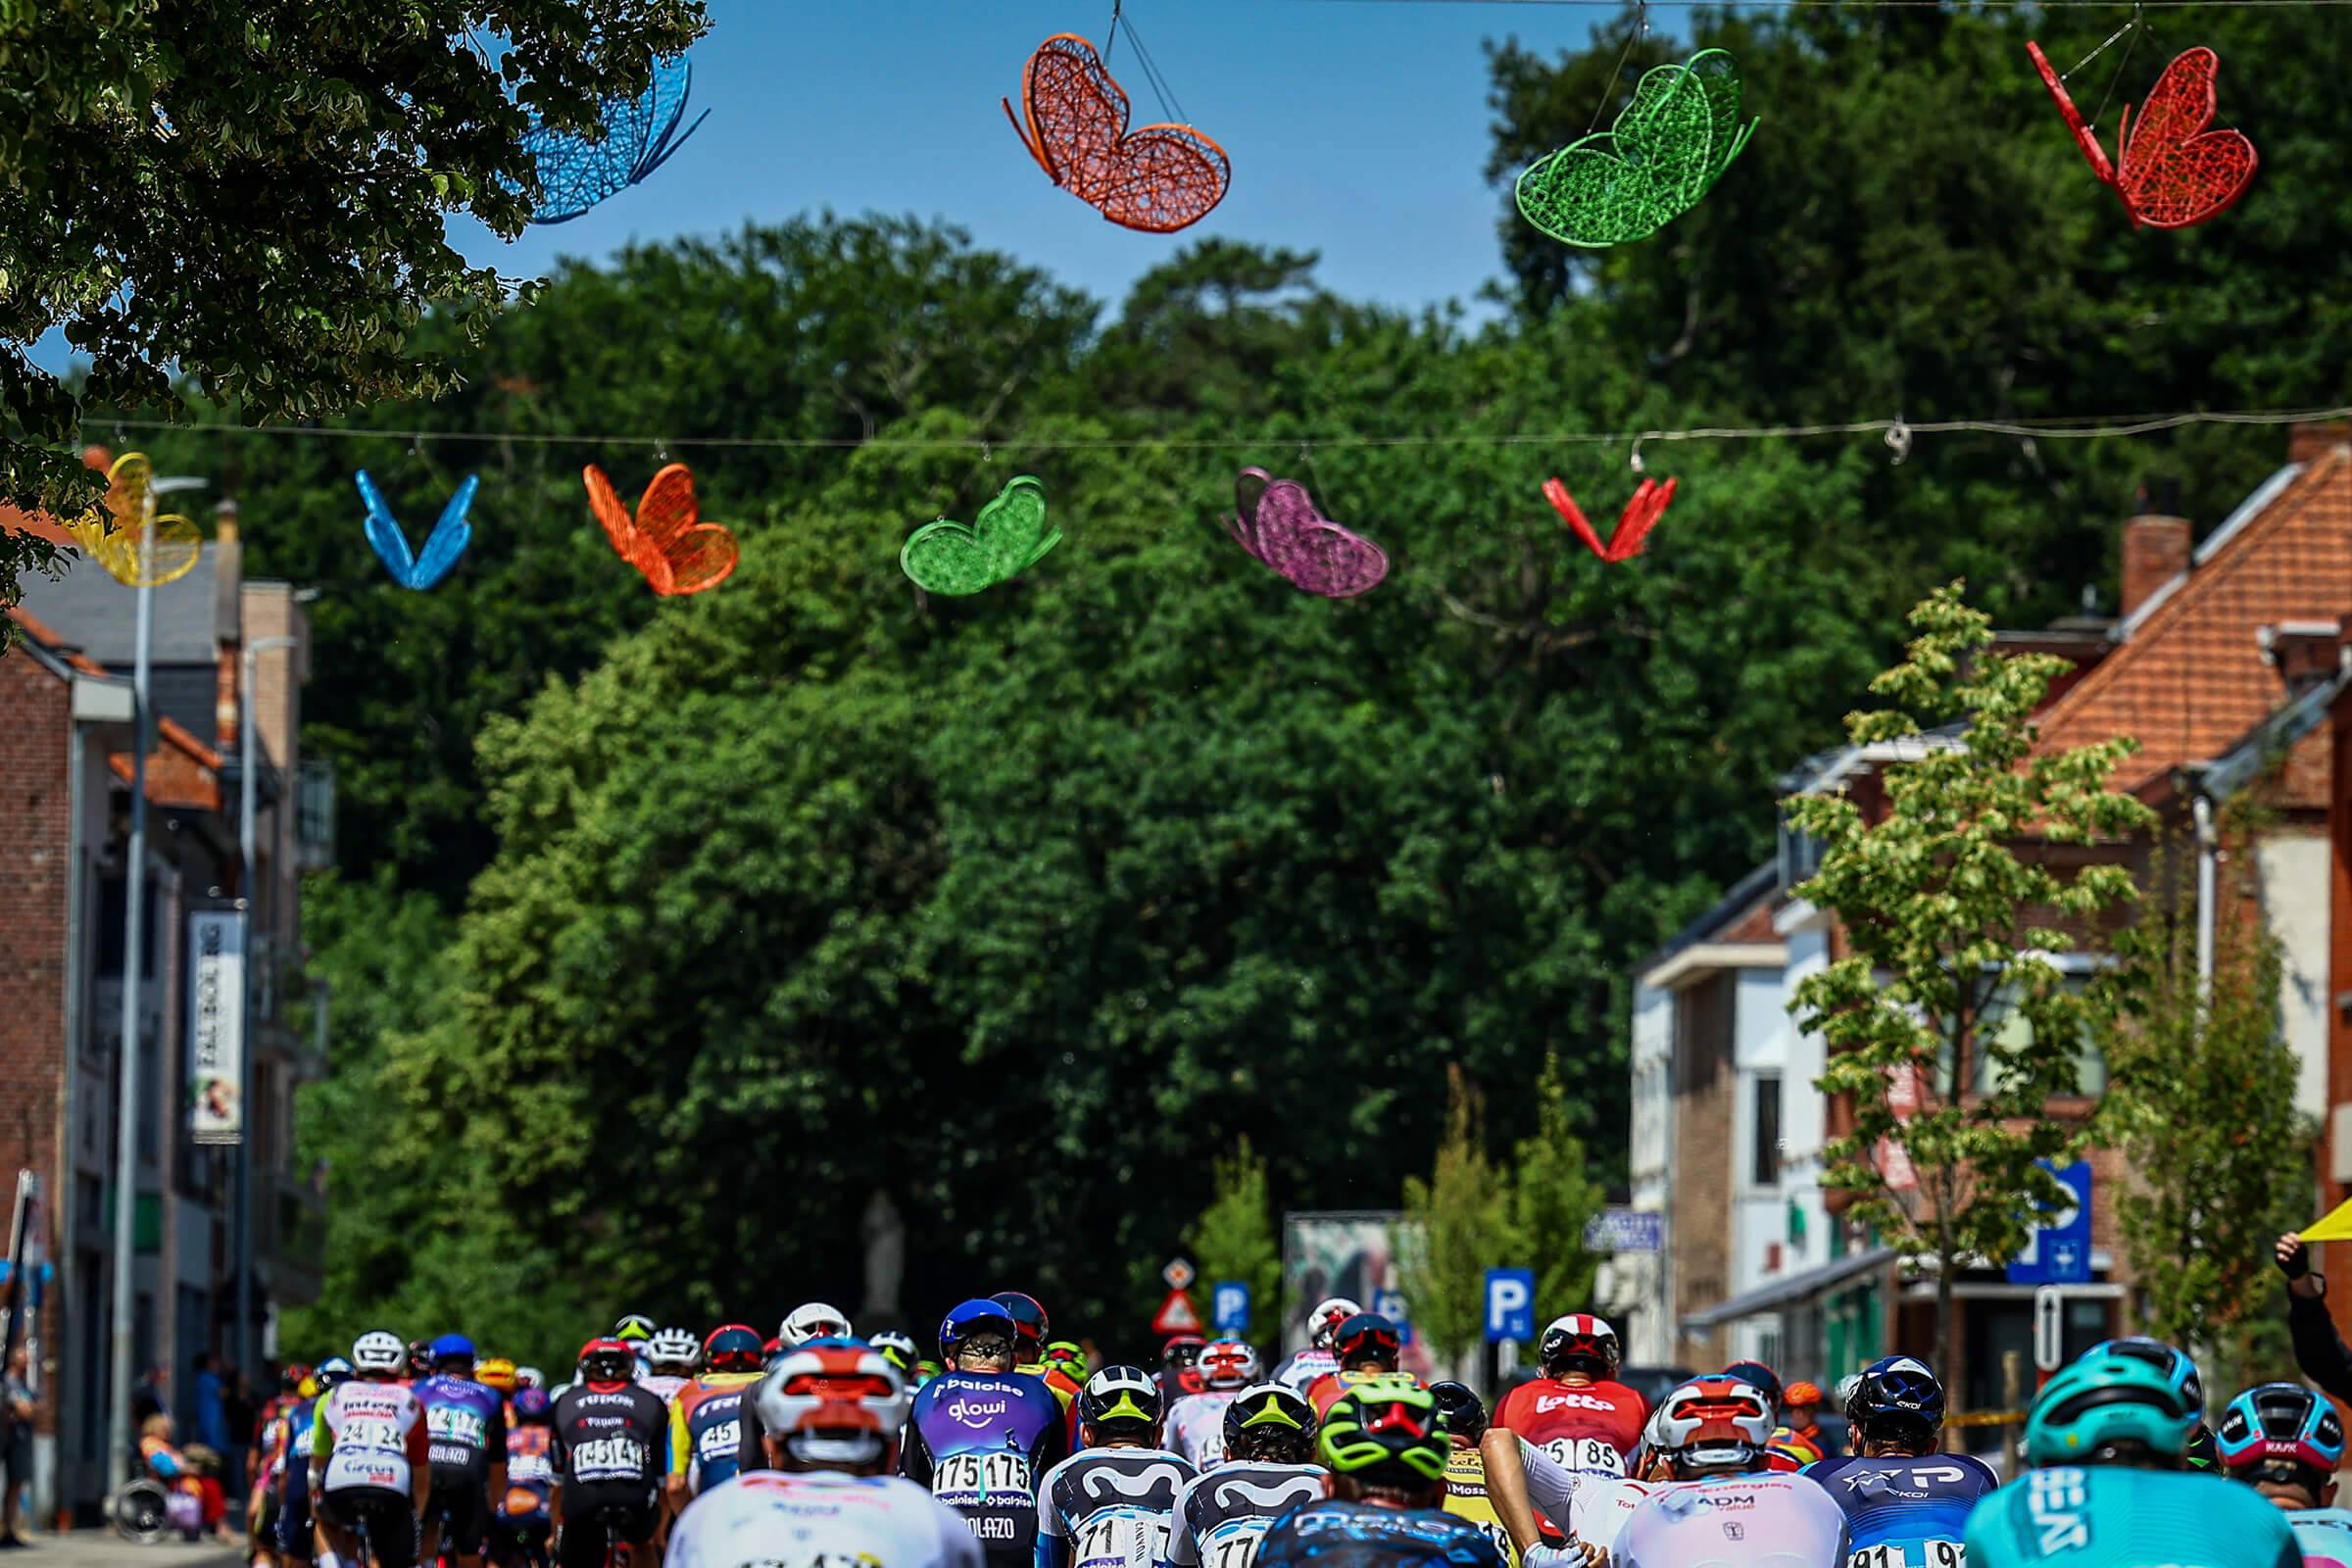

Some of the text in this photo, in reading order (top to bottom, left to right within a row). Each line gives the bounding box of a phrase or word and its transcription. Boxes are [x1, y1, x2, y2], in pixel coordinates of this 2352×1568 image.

[1217, 1289, 1246, 1323] P
[1491, 1279, 1527, 1330] P
[948, 1397, 1006, 1422] glowi
[1536, 1394, 1616, 1414] Lotto
[708, 1421, 731, 1444] 45
[1587, 1440, 1616, 1469] 85
[936, 1453, 1029, 1491] 175 175
[996, 1494, 1032, 1508] baloise
[1697, 1494, 1756, 1506] ADM
[959, 1516, 1015, 1540] OLAZO
[1083, 1519, 1113, 1557] 71
[1217, 1536, 1254, 1568] 77
